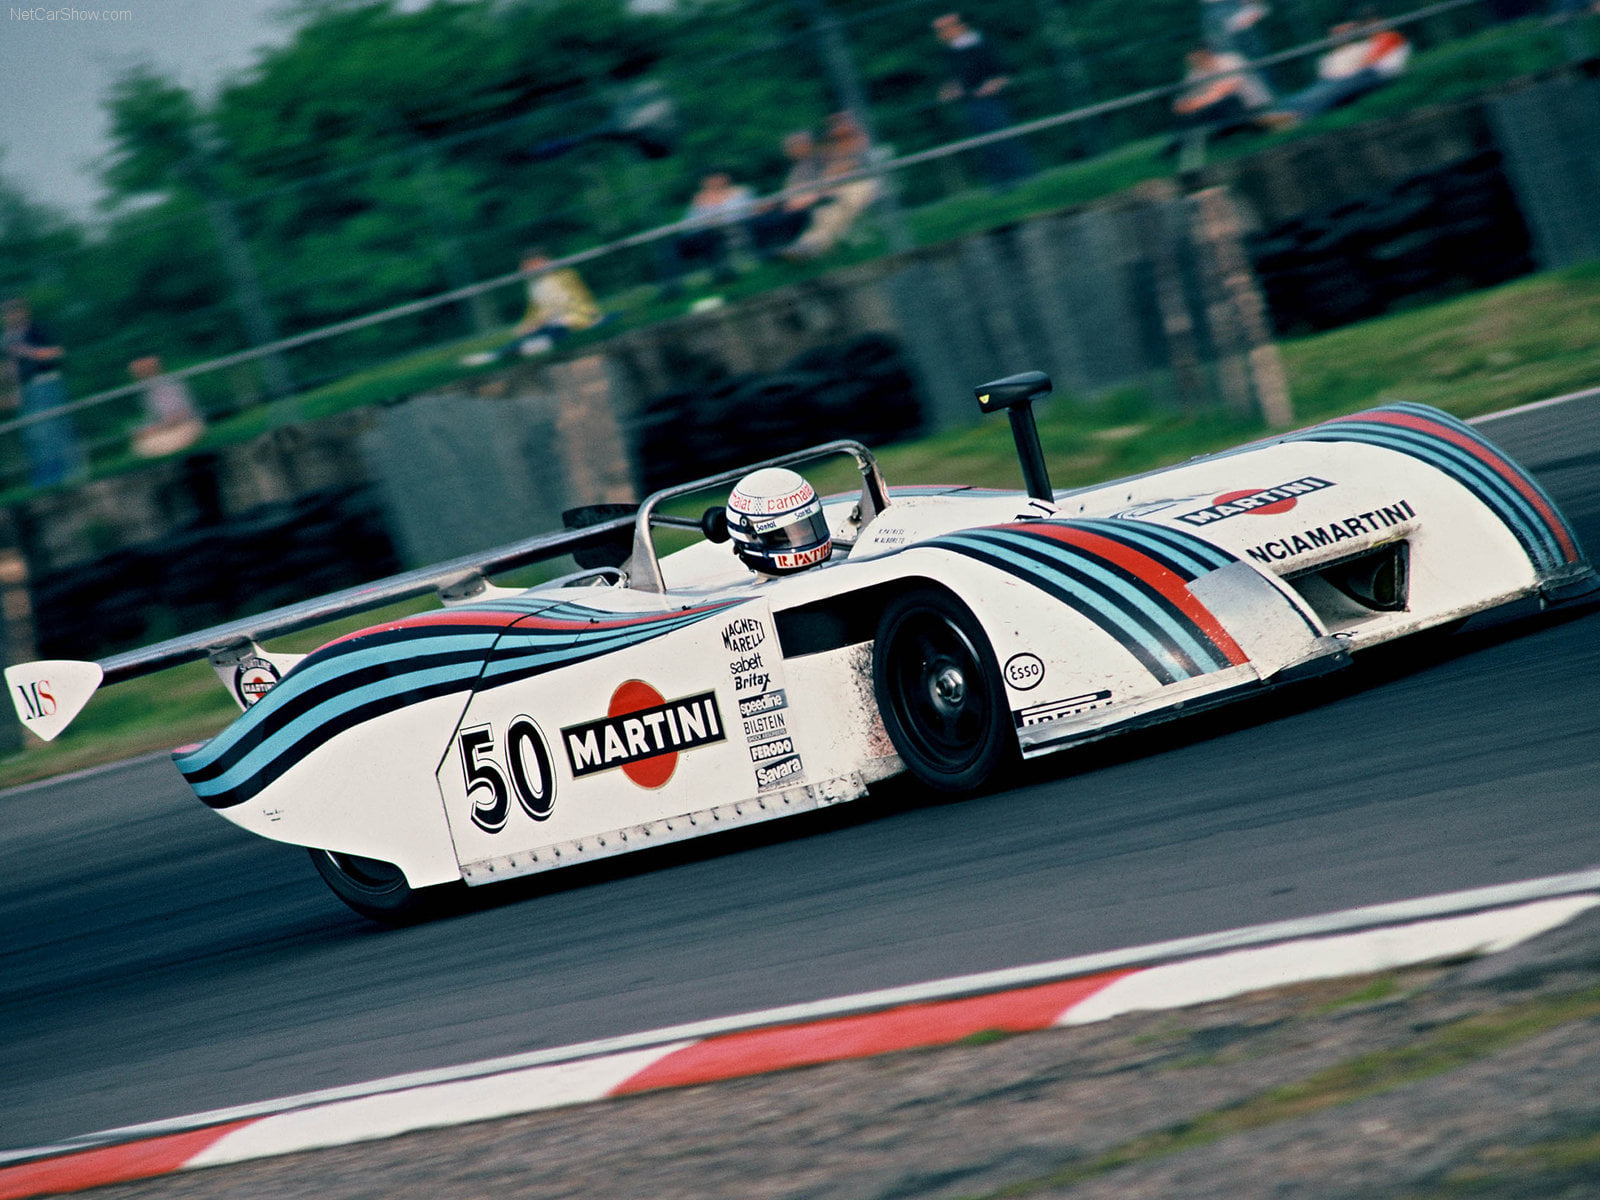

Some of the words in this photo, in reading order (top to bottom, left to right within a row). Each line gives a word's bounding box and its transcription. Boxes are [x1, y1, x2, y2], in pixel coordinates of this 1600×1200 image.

[1185, 477, 1326, 526] MARTINI
[730, 652, 764, 675] sabelt
[735, 672, 772, 692] Britax
[740, 694, 783, 717] speedline
[568, 699, 720, 770] MARTINI
[743, 713, 786, 735] BILSTEIN
[751, 739, 792, 761] FERODO
[458, 713, 558, 835] 50
[757, 758, 801, 786] Savara
